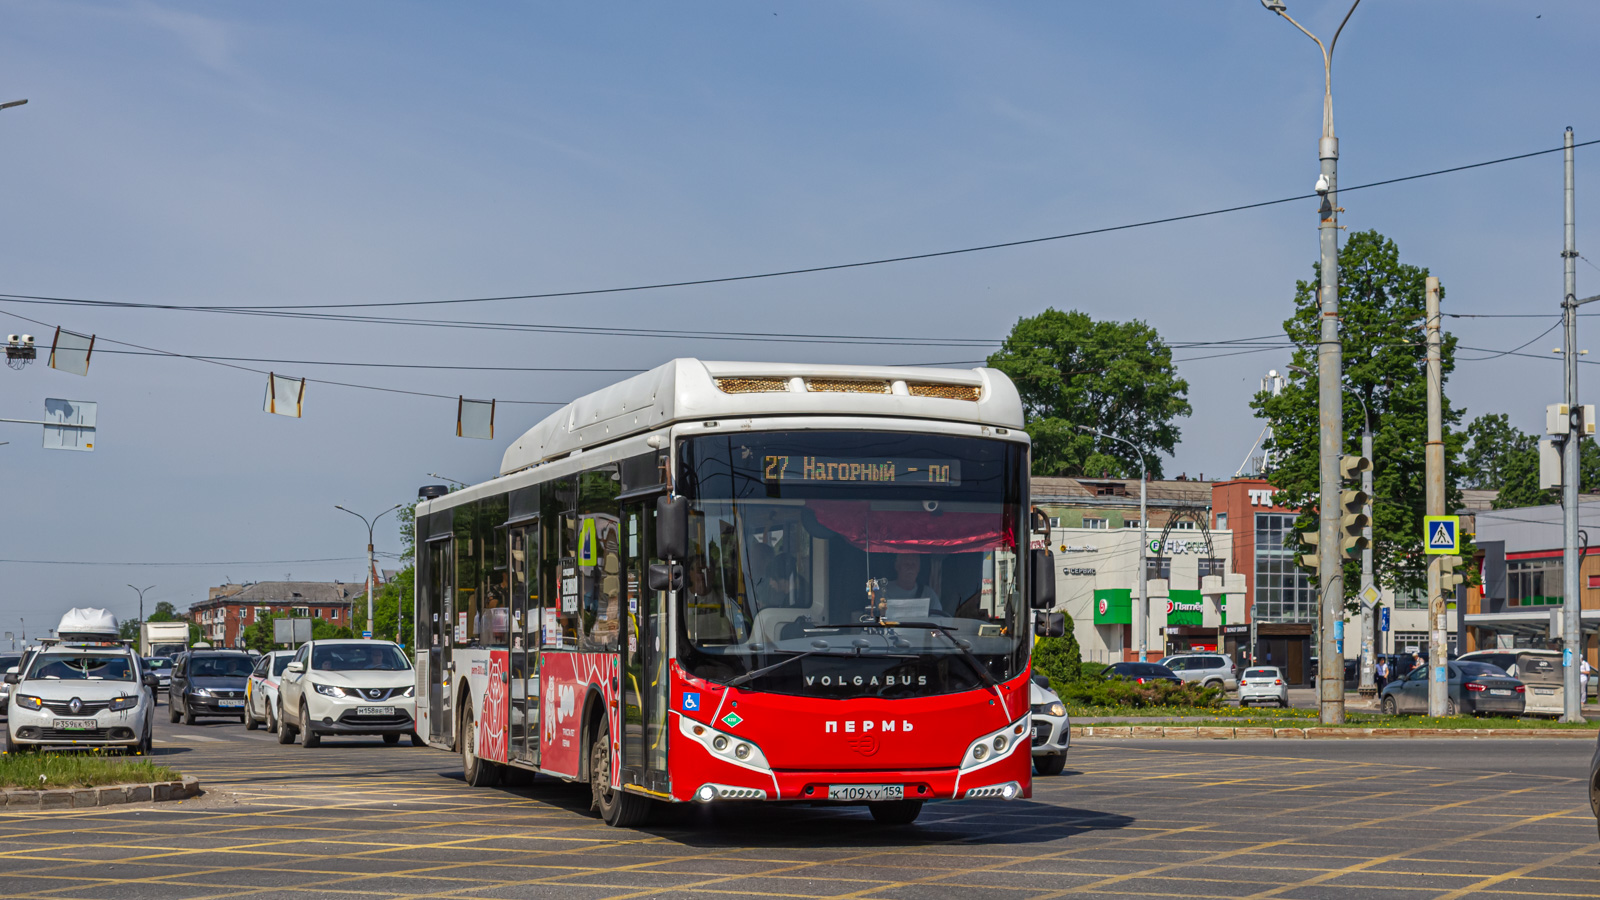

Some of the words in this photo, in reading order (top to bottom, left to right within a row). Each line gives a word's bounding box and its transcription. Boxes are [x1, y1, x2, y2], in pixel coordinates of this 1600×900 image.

[765, 455, 789, 480] 27
[803, 456, 896, 482] Нагорный
[1248, 489, 1273, 507] ТЦ
[1070, 568, 1096, 576] СЕРВИС
[805, 675, 927, 686] VOLGABUS
[825, 720, 914, 733] ПЕРМЬ
[833, 787, 881, 799] К109ХУ
[883, 786, 901, 796] 159
